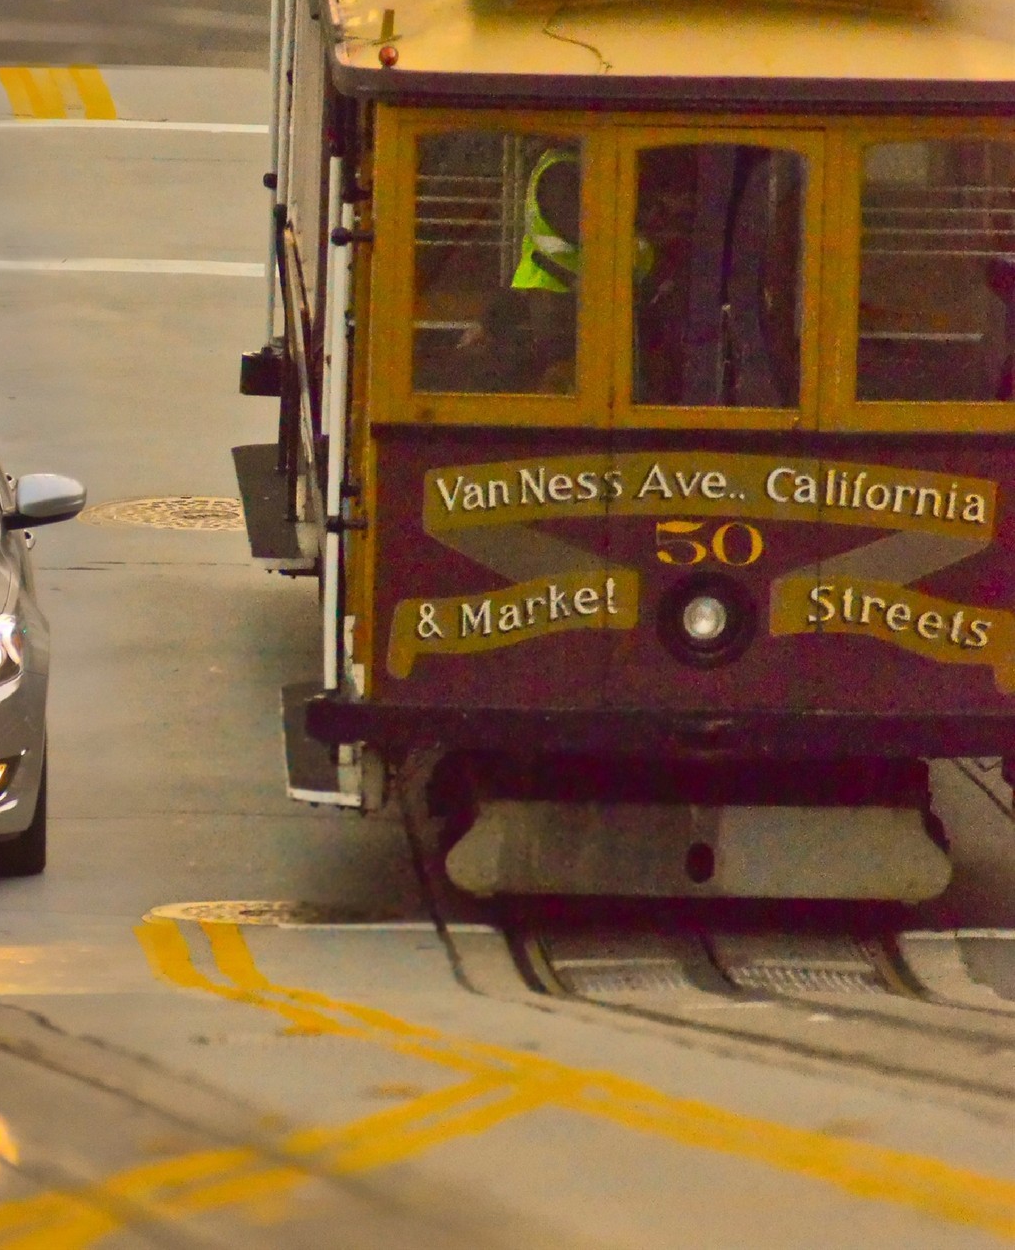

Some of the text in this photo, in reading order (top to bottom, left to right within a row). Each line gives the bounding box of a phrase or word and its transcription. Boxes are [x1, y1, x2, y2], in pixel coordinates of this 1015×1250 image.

[436, 476, 510, 511] Van
[519, 467, 624, 504] Ness
[766, 467, 987, 524] California
[655, 520, 764, 566] 50
[417, 577, 992, 647] & Market Streets
